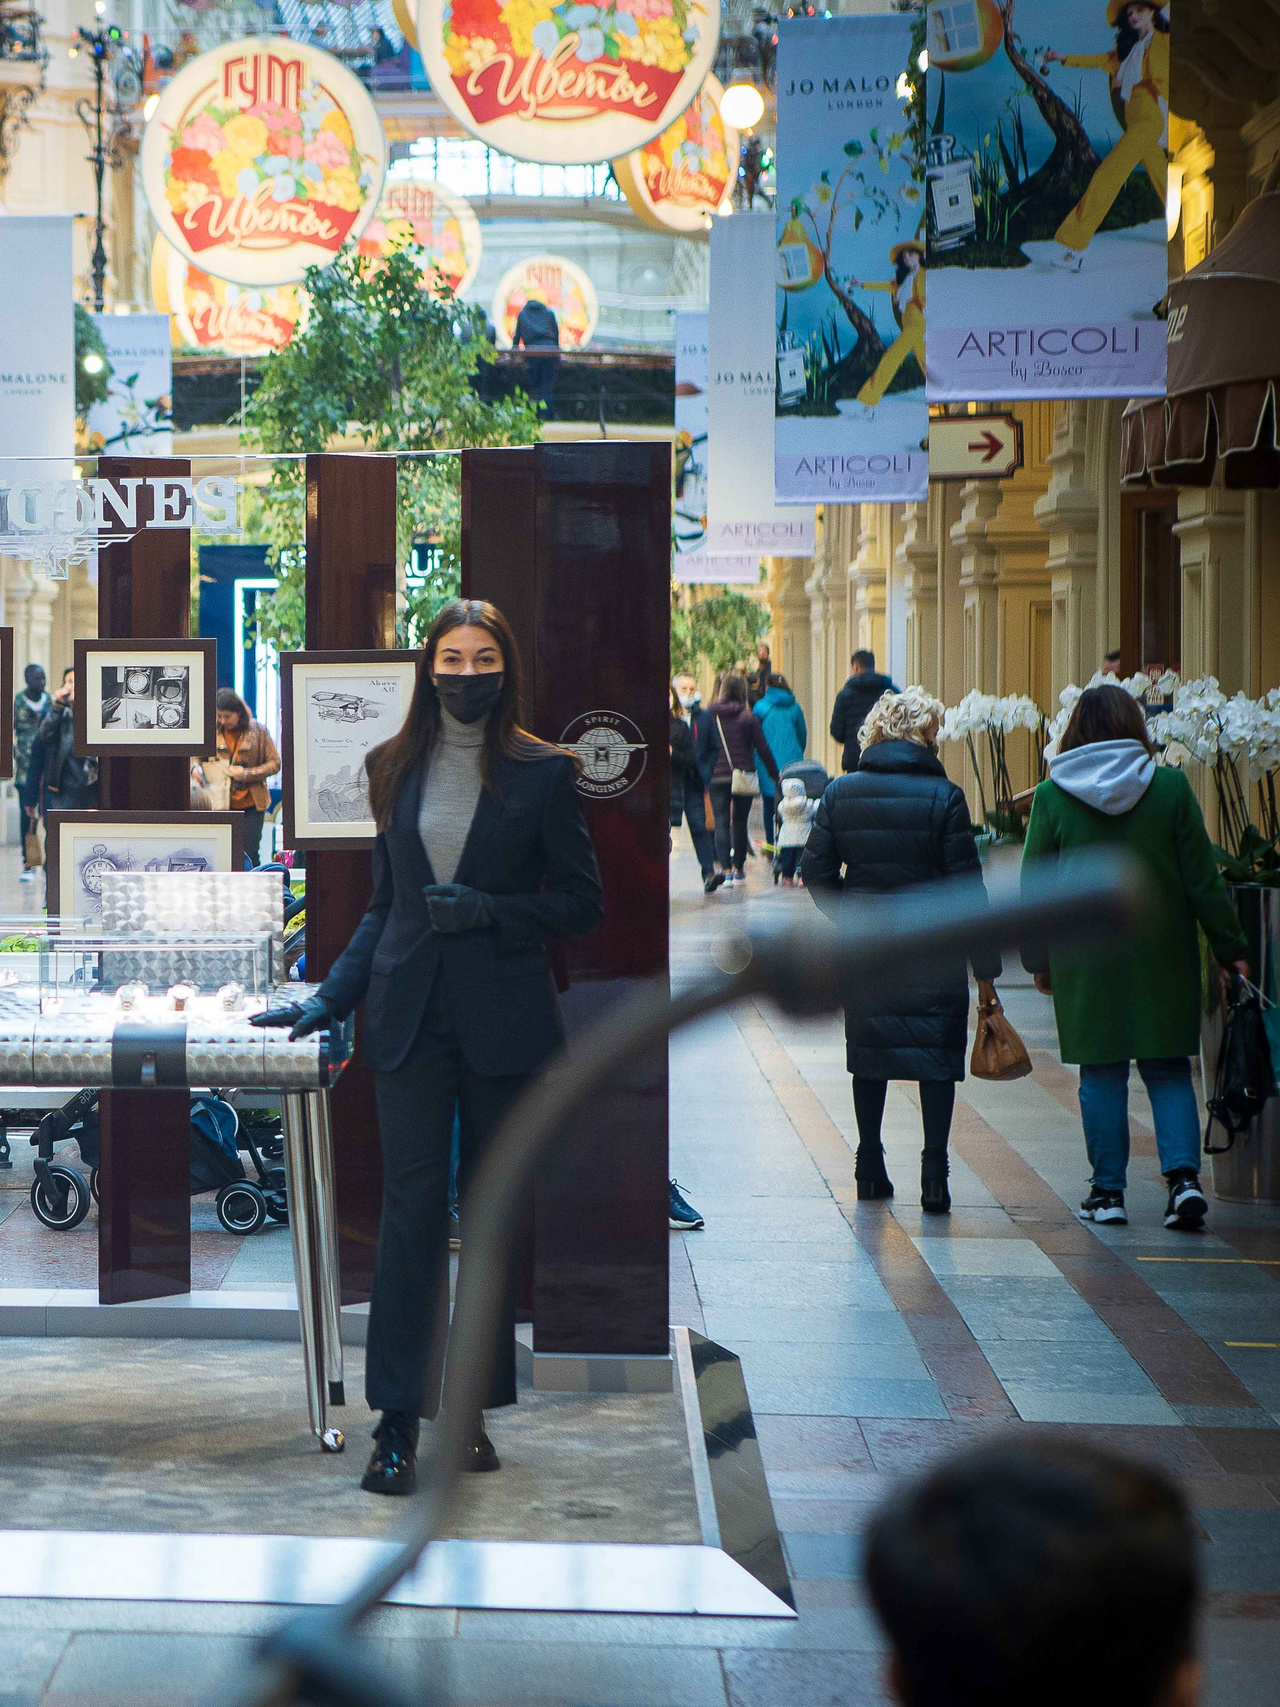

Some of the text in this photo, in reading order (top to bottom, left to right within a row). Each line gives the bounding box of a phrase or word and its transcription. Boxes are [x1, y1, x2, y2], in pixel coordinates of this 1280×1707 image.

[225, 54, 306, 112] ГУМ
[467, 32, 658, 120] Цветы
[786, 76, 899, 96] JO MALO
[827, 98, 883, 110] LONDON
[184, 177, 339, 249] Цветы
[957, 326, 1140, 358] ARTICOLI
[0, 372, 69, 384] MALONE
[714, 371, 734, 385] JO
[1010, 359, 1083, 382] by Bosco
[794, 454, 911, 477] ARTICOLI
[721, 521, 804, 538] ARTICOLI
[584, 716, 620, 726] SPIRIT
[576, 777, 629, 793] LONGINES
